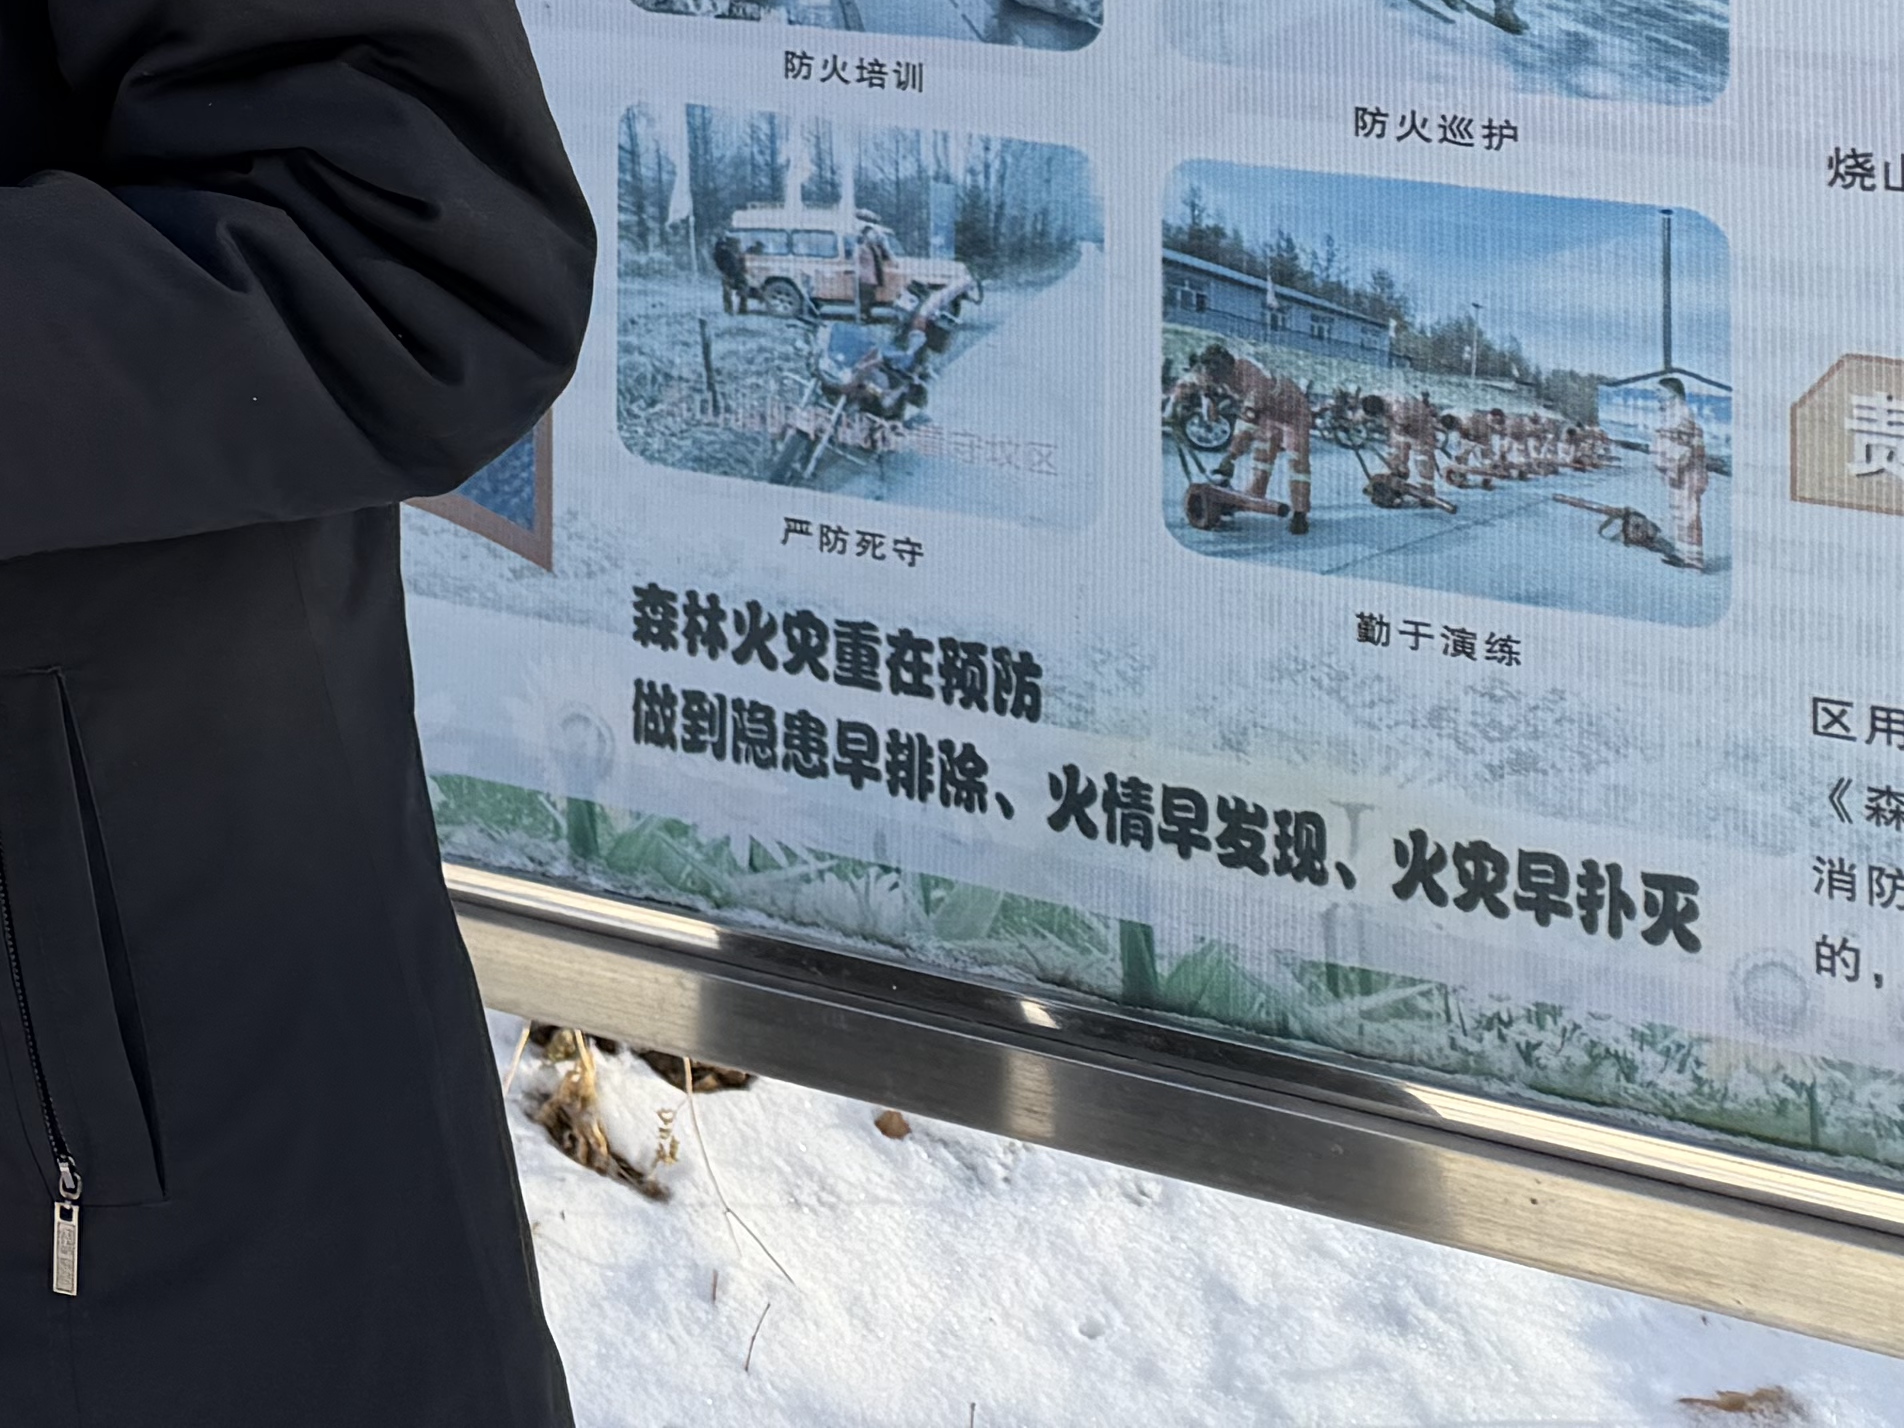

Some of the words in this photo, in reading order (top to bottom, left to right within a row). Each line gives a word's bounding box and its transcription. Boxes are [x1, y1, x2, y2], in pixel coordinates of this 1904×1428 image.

[784, 50, 924, 93] 防火培训
[1353, 106, 1520, 152] 防火巡护
[781, 517, 925, 568] 严防死守
[632, 582, 1042, 723] 森林火灾重在预防
[1355, 612, 1523, 667] 勤于演练
[632, 678, 1702, 954] 做到隐患早排除、火情早发现、火灾早扑灭
[1816, 934, 1884, 989] 的，
